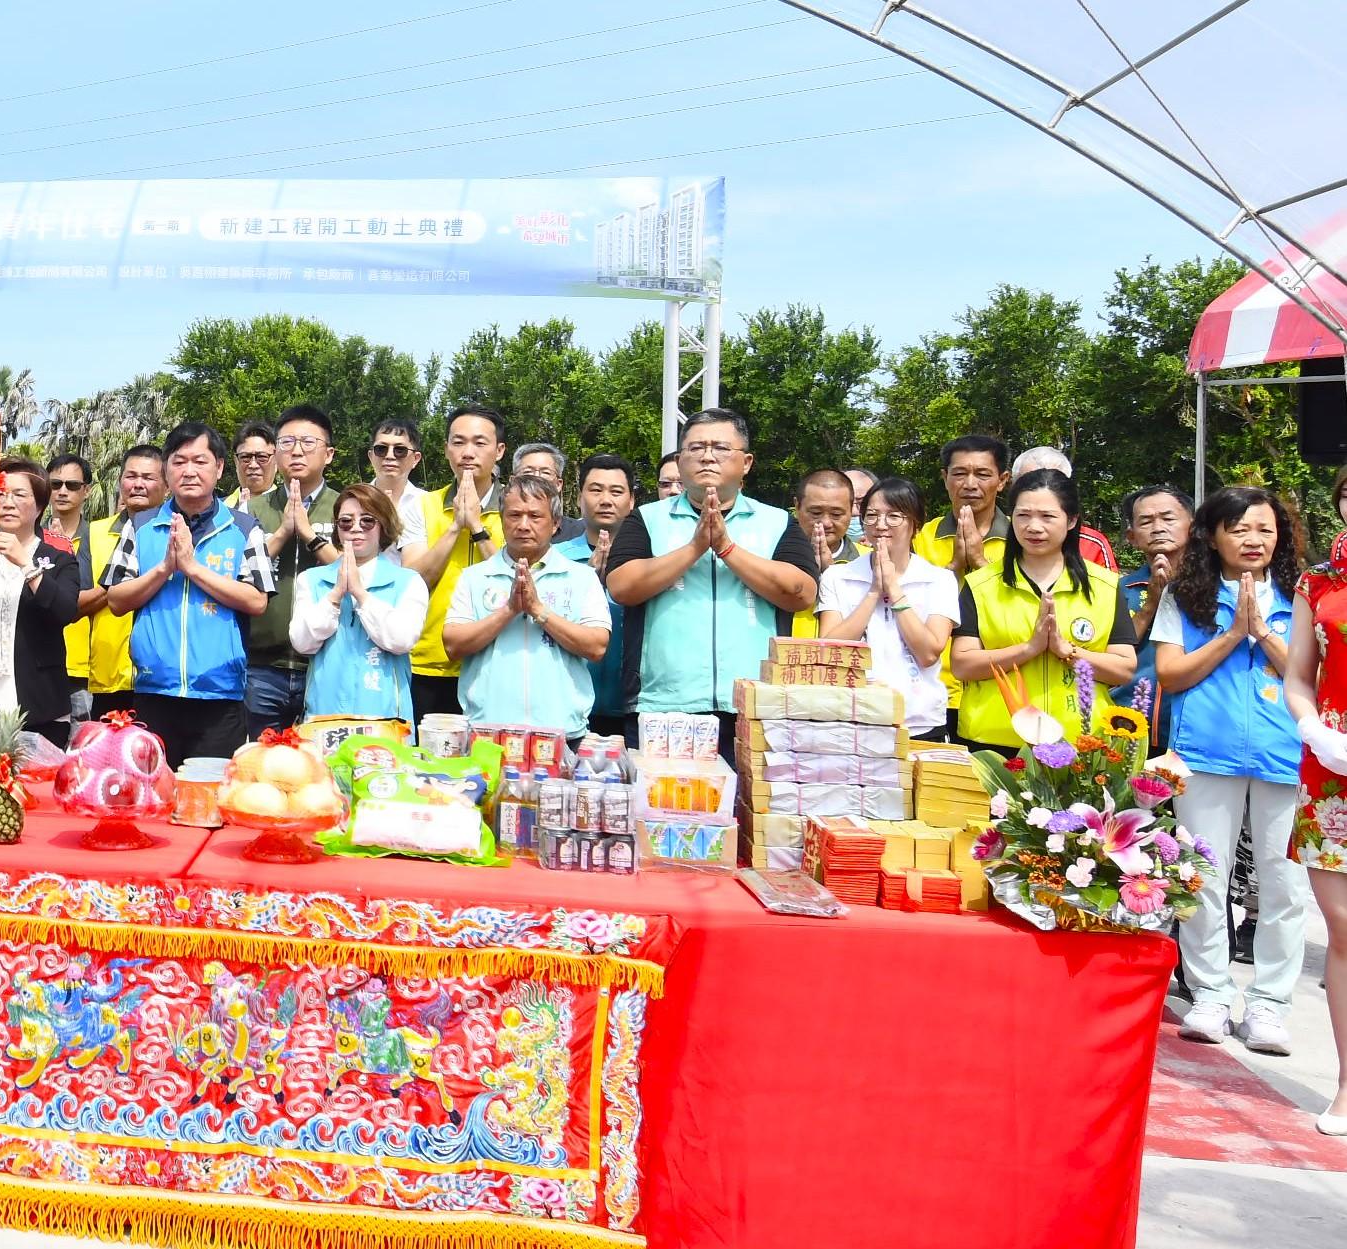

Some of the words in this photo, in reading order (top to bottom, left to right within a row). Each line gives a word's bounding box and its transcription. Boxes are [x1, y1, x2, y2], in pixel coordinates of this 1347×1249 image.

[219, 216, 465, 238] 新建工程開工動土典禮
